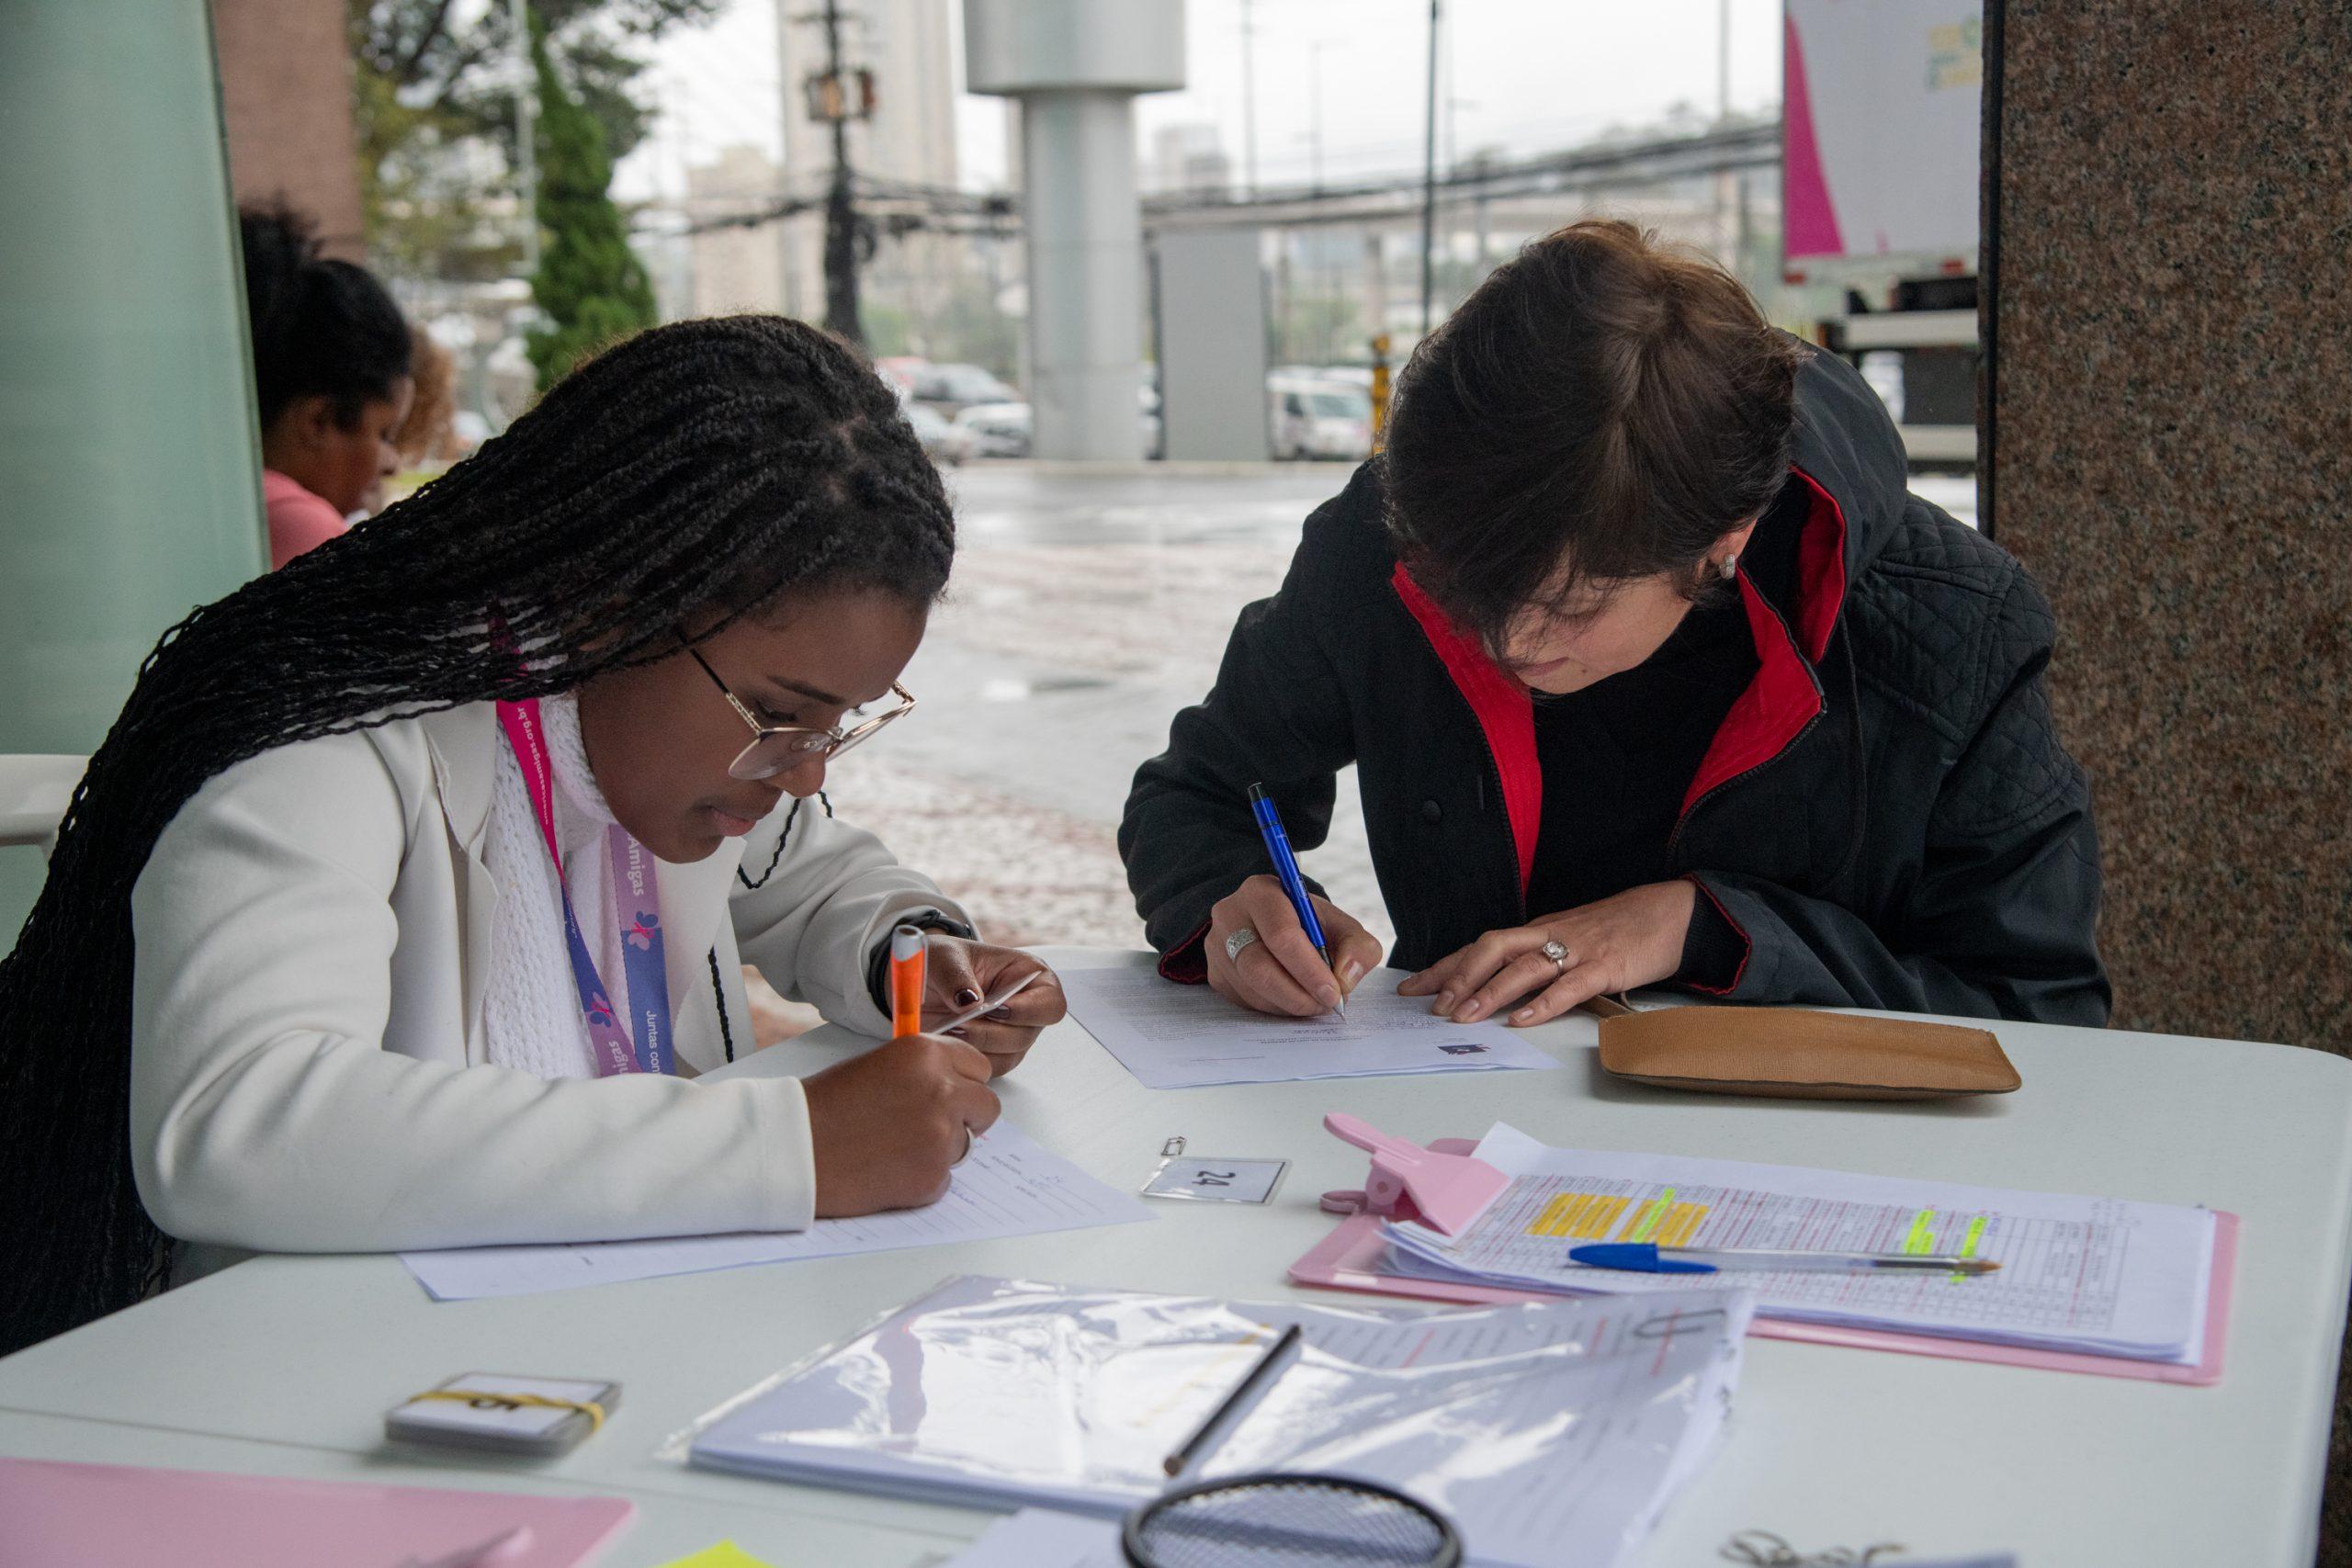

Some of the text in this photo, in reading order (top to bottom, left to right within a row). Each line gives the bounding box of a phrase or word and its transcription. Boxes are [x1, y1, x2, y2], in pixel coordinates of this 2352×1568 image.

[627, 837, 645, 897] Amigas
[646, 1010, 661, 1074] Juntas con
[1192, 1170, 1236, 1186] 24
